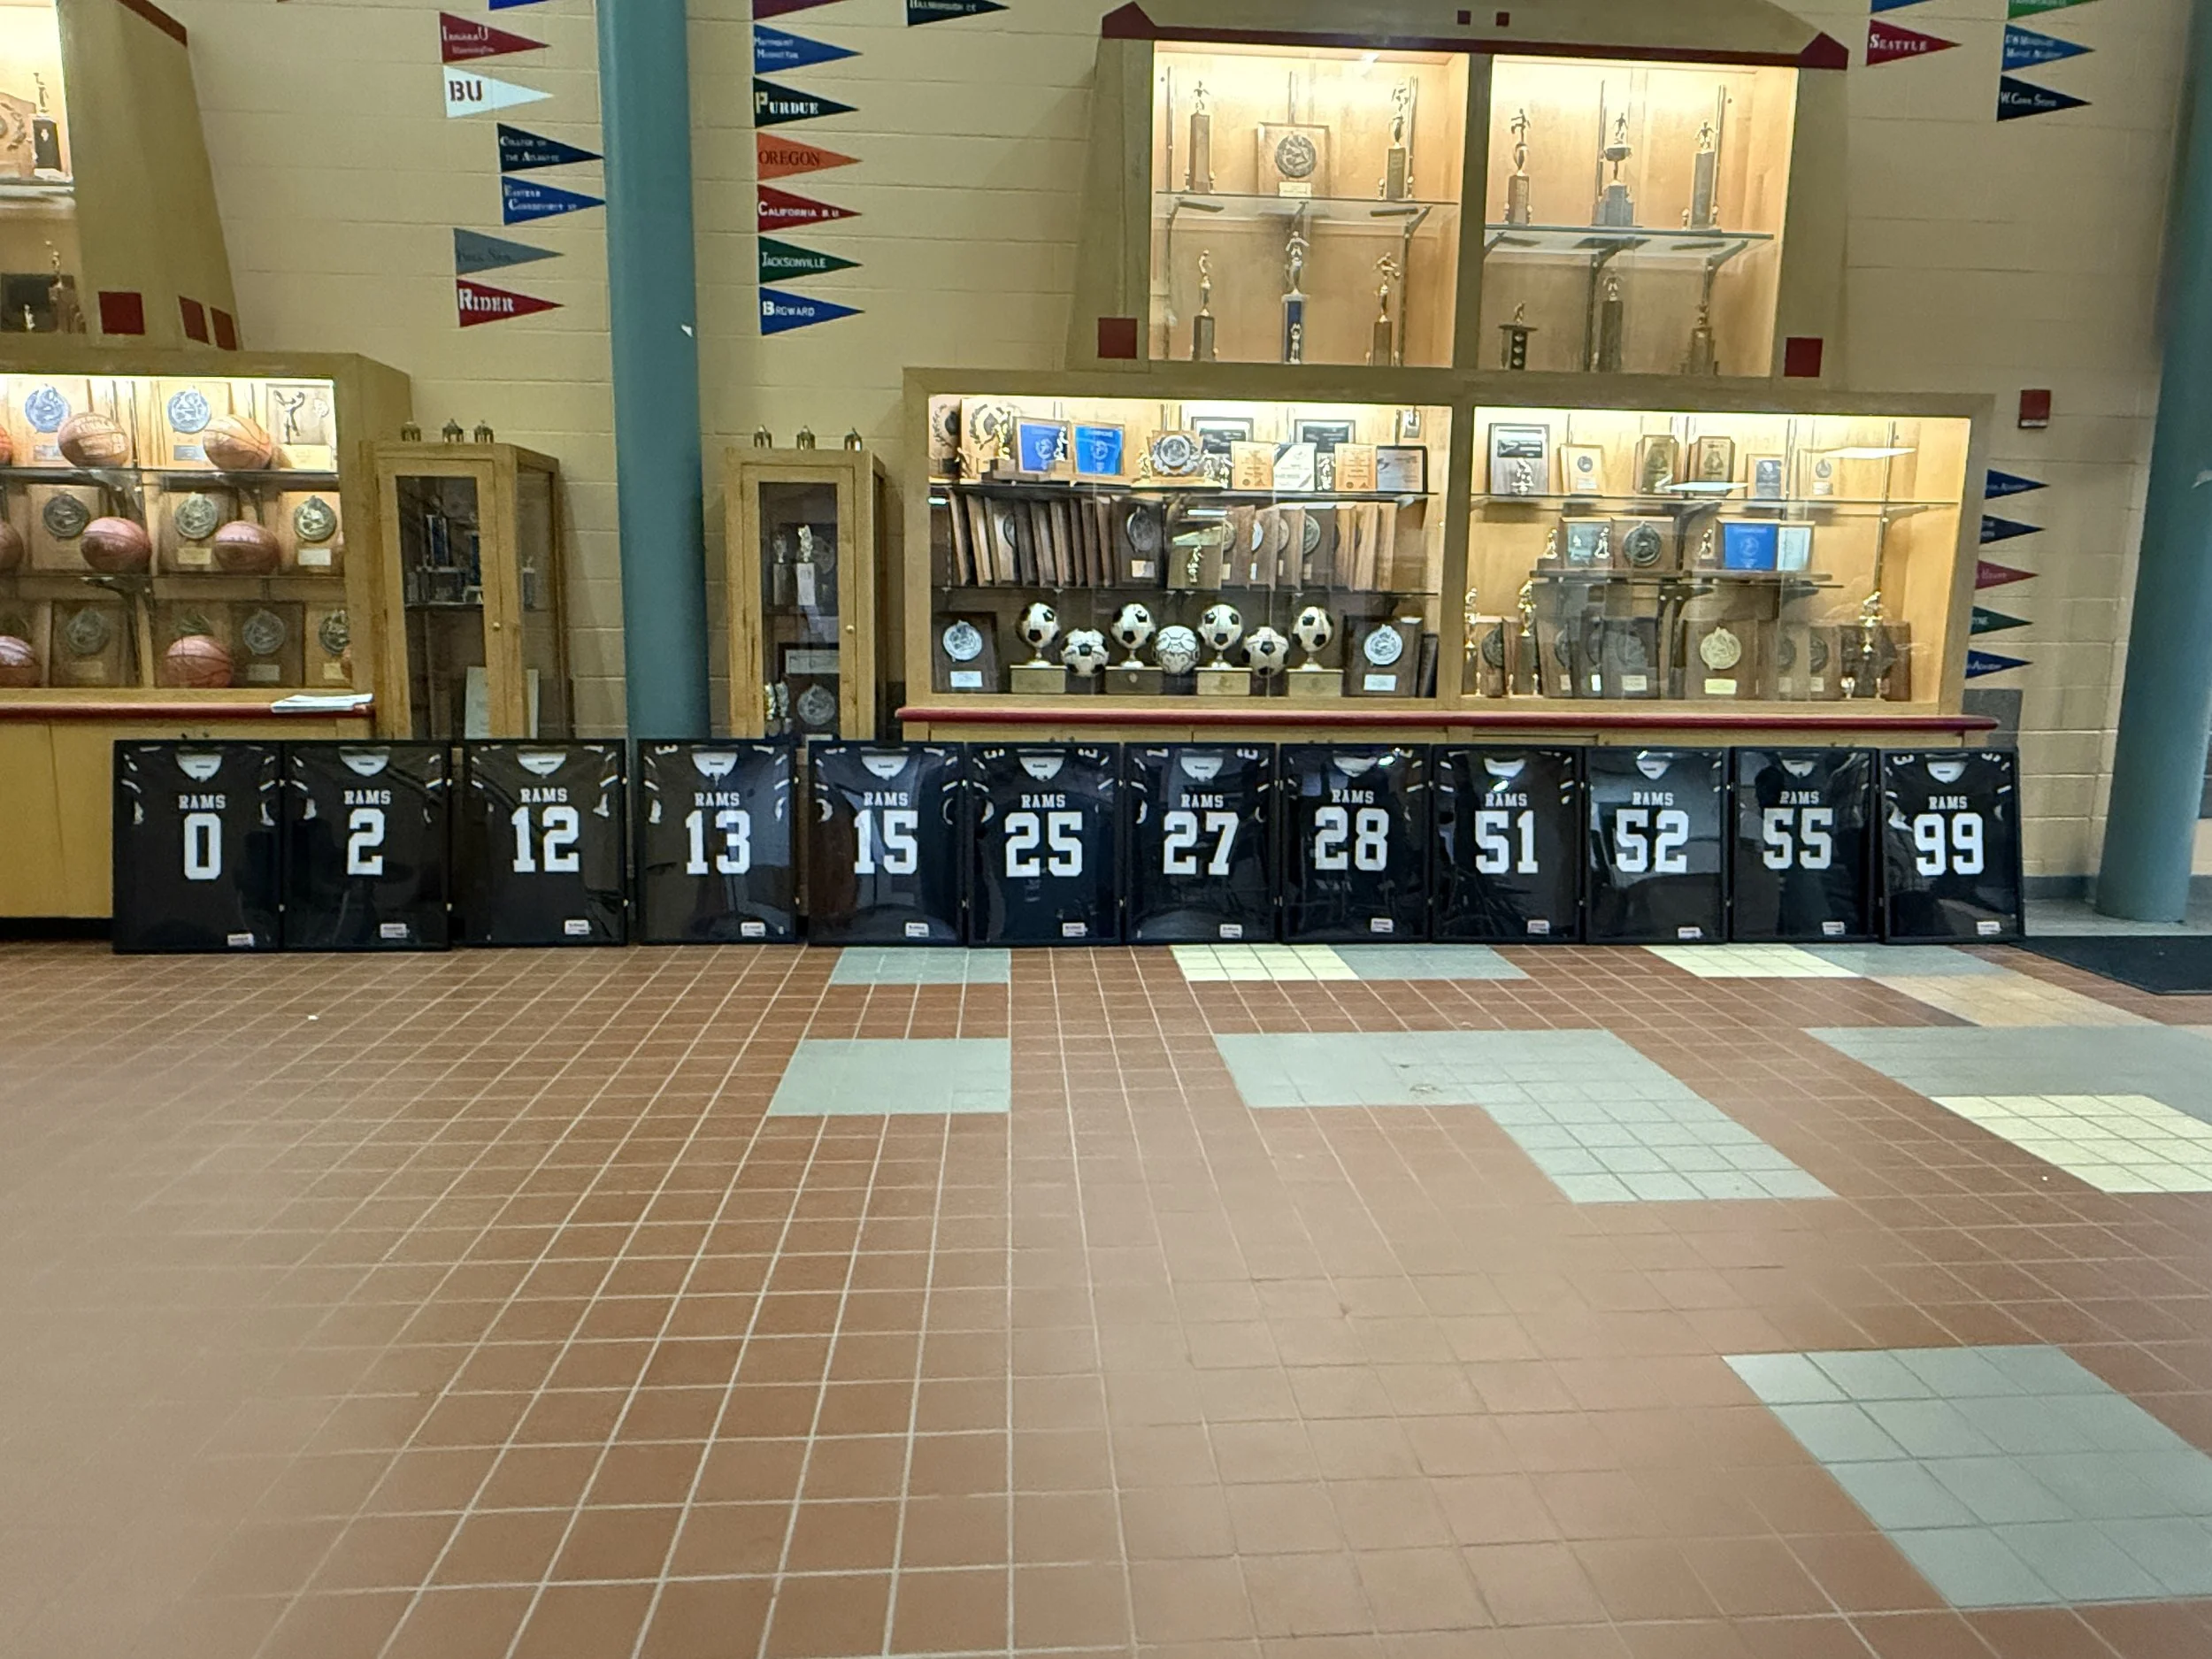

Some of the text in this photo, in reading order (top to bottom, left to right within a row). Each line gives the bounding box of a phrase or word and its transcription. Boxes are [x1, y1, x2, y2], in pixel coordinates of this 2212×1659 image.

[449, 81, 482, 102] BU
[755, 91, 819, 115] PURDUE
[758, 150, 820, 167] OREGON
[458, 288, 515, 312] RIDER
[762, 300, 815, 318] BROWARD
[179, 795, 226, 810] RAMS
[344, 789, 391, 806] RAMS
[520, 787, 568, 803] RAMS
[694, 792, 741, 808] RAMS
[864, 791, 909, 807] RAMS
[1021, 794, 1066, 809] RAMS
[1180, 794, 1224, 809] RAMS
[1332, 789, 1374, 804] RAMS
[1485, 793, 1528, 808] RAMS
[1632, 792, 1674, 807] RAMS
[1779, 790, 1820, 806] RAMS
[1929, 795, 1968, 810] RAMS
[183, 812, 222, 880] 0
[347, 807, 386, 876] 2
[511, 805, 580, 873] 12
[685, 810, 751, 875] 13
[853, 810, 918, 875] 15
[1004, 811, 1083, 878] 25
[1163, 810, 1240, 876] 27
[1314, 806, 1390, 872] 28
[1474, 810, 1540, 874] 51
[1615, 809, 1690, 874] 52
[1762, 807, 1833, 870] 55
[1912, 812, 1985, 877] 99
